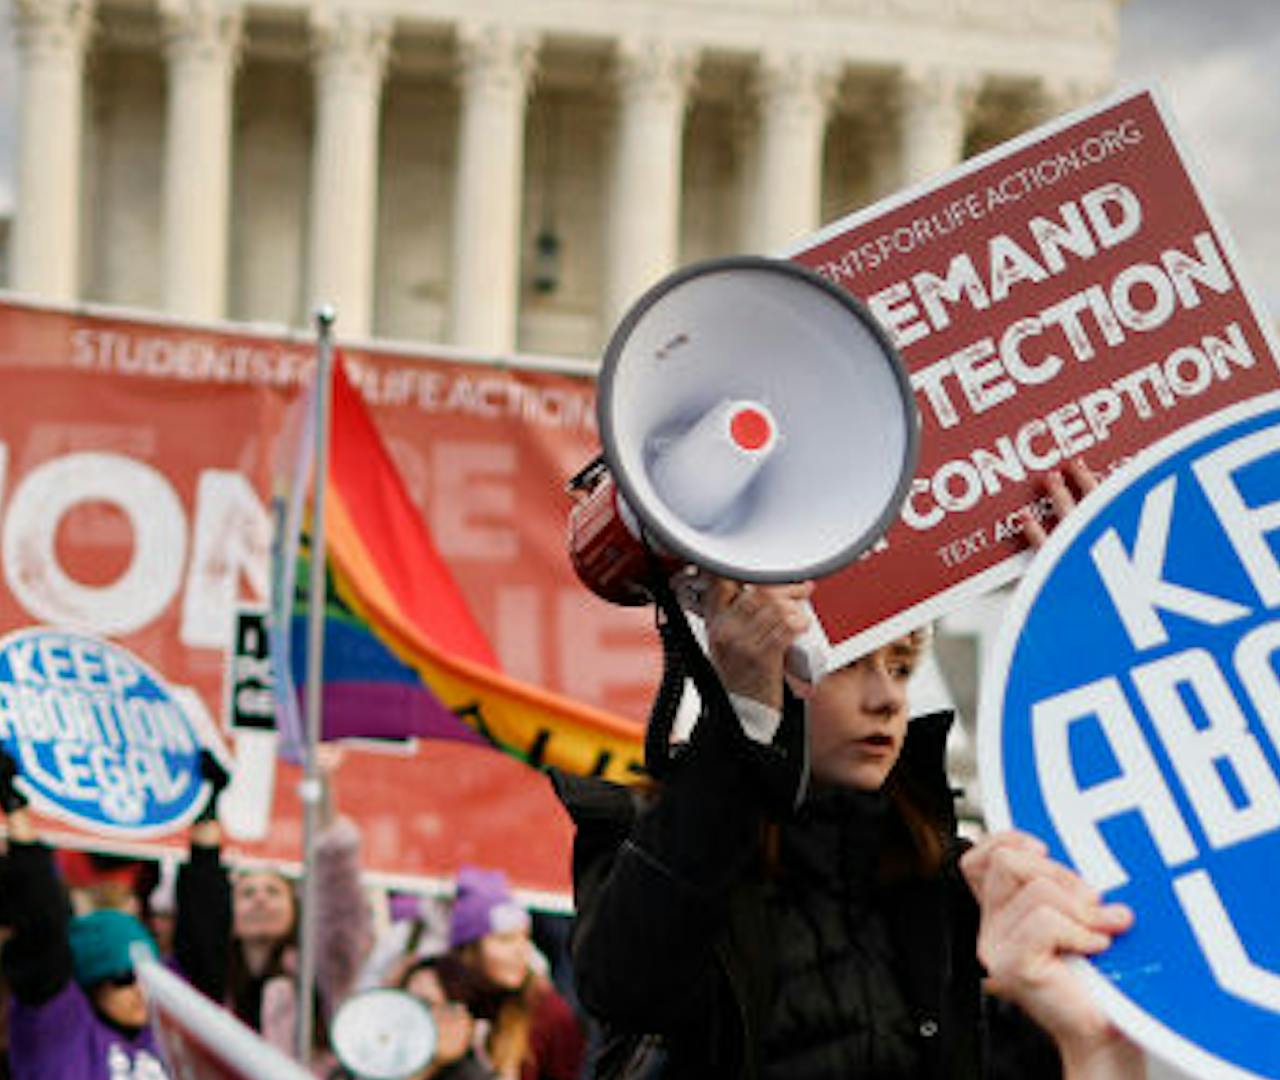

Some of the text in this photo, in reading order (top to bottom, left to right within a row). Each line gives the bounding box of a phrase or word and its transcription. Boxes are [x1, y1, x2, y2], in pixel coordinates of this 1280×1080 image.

[868, 183, 1142, 350] EMAND
[910, 231, 1234, 430] TECTION
[901, 322, 1257, 530] CONCEPTION
[938, 528, 989, 568] TEXT
[4, 634, 141, 690] KEEP
[18, 732, 191, 808] LEGAL
